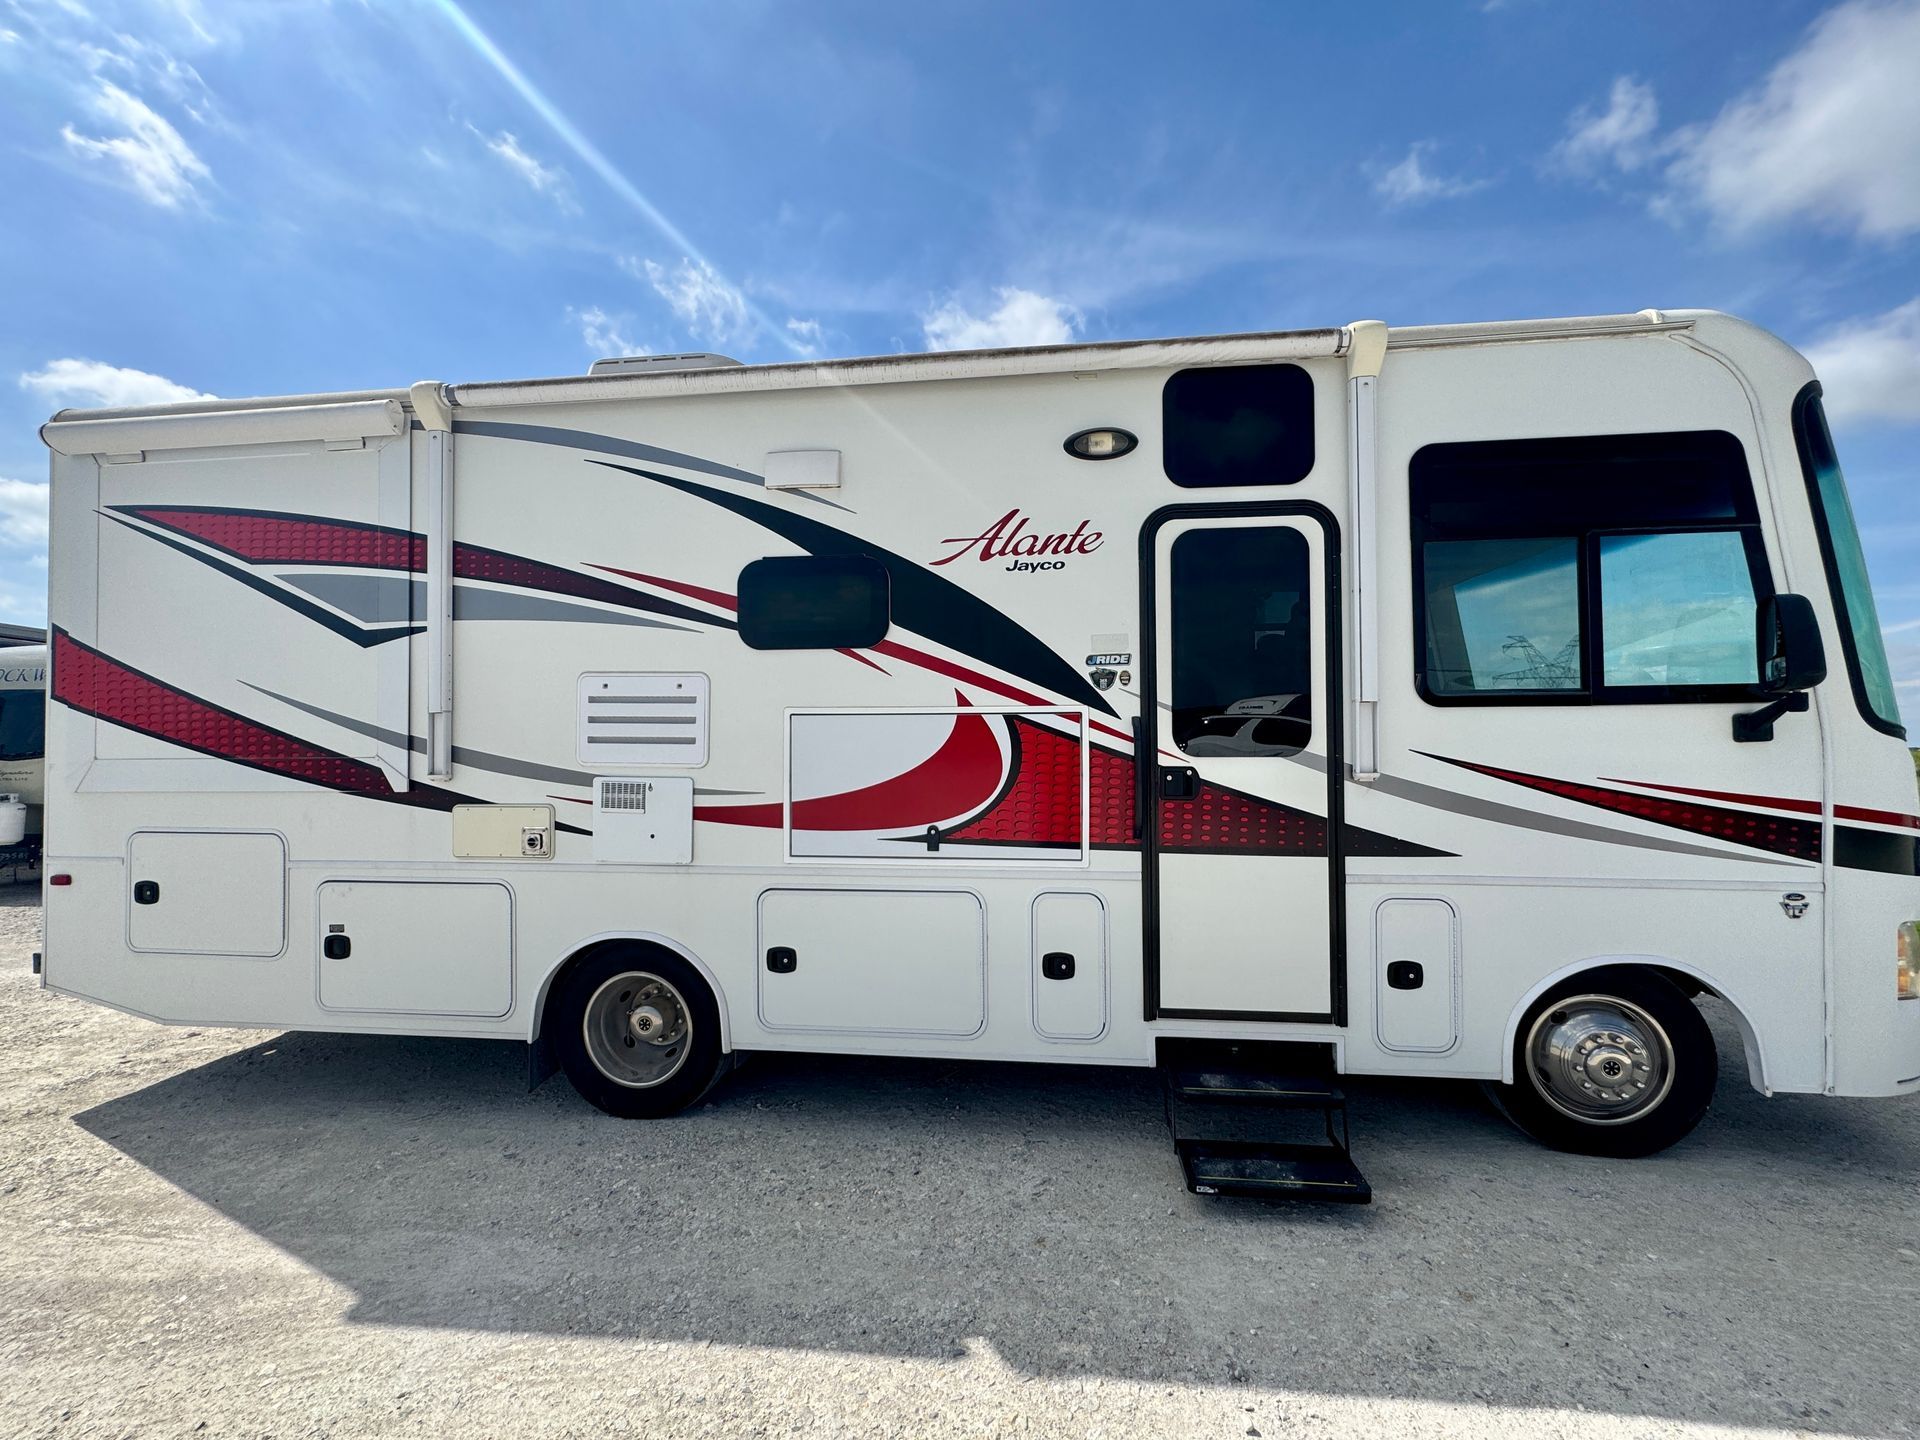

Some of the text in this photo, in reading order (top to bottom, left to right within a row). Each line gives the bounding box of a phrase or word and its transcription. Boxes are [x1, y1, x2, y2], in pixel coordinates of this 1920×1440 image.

[929, 508, 1105, 565] Alante
[1005, 560, 1066, 573] Jayco
[1087, 654, 1130, 665] JRIDE
